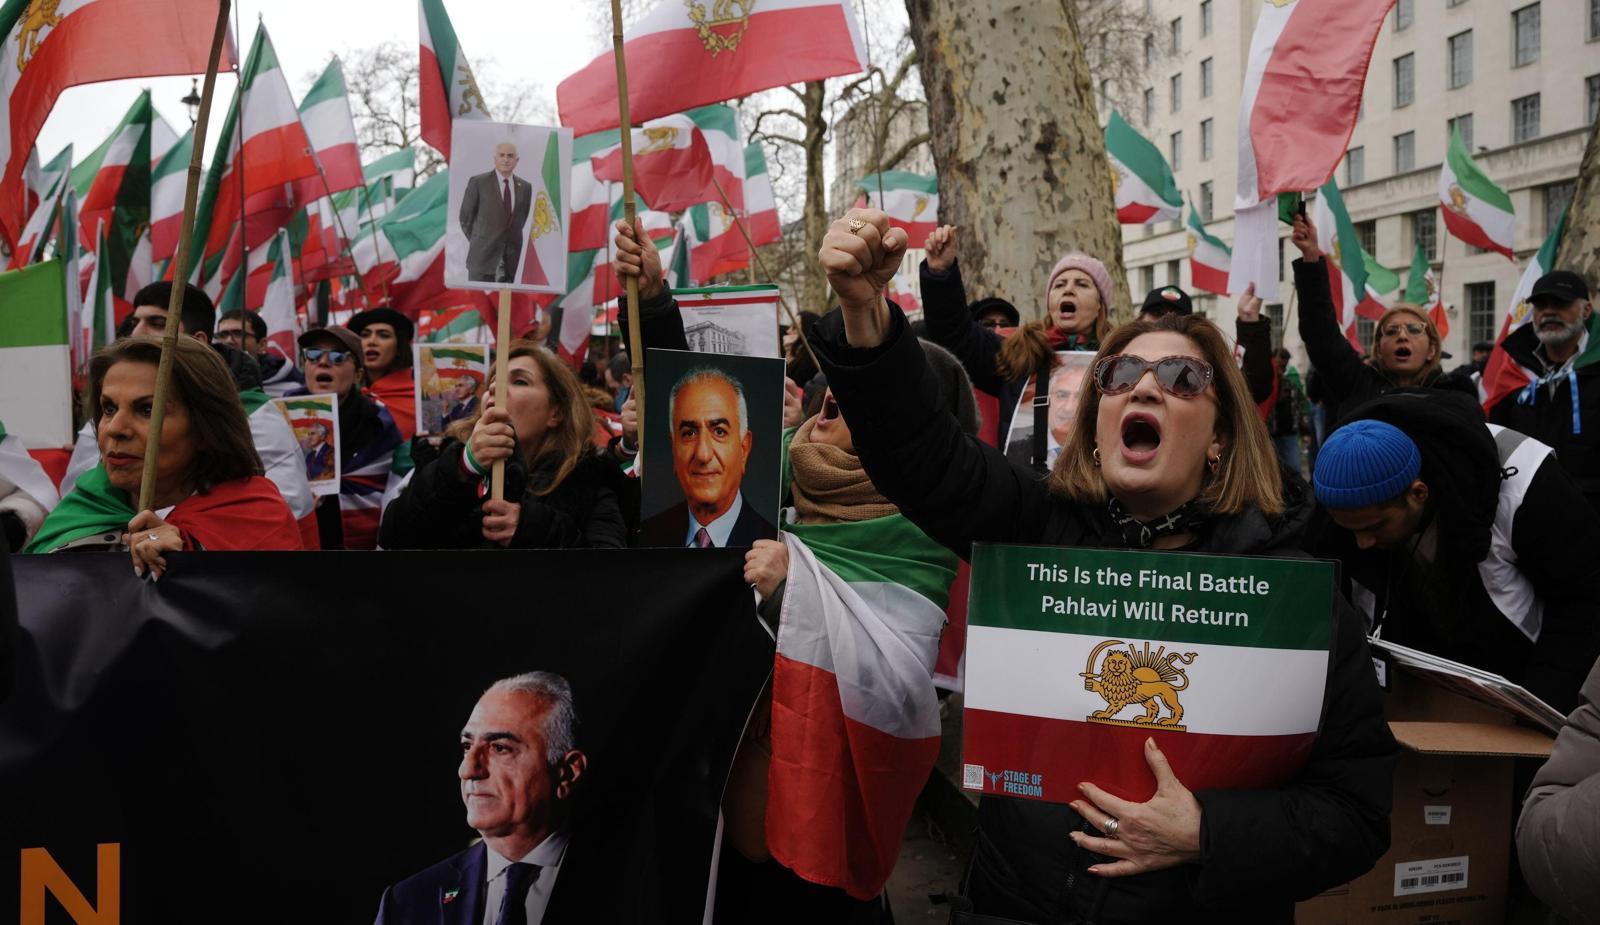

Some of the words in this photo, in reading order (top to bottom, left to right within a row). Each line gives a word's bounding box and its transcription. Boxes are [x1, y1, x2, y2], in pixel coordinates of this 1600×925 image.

[1027, 563, 1068, 583] This
[1074, 566, 1090, 585] Is
[1096, 567, 1132, 587] the
[1138, 569, 1192, 591] Final
[1199, 573, 1270, 596] Battle
[1041, 595, 1117, 618] Pahlavi
[1123, 601, 1165, 622] Will
[1171, 604, 1249, 627] Return
[1003, 769, 1029, 784] STAGE
[1031, 774, 1042, 785] OF
[1003, 781, 1043, 797] FREEDOM
